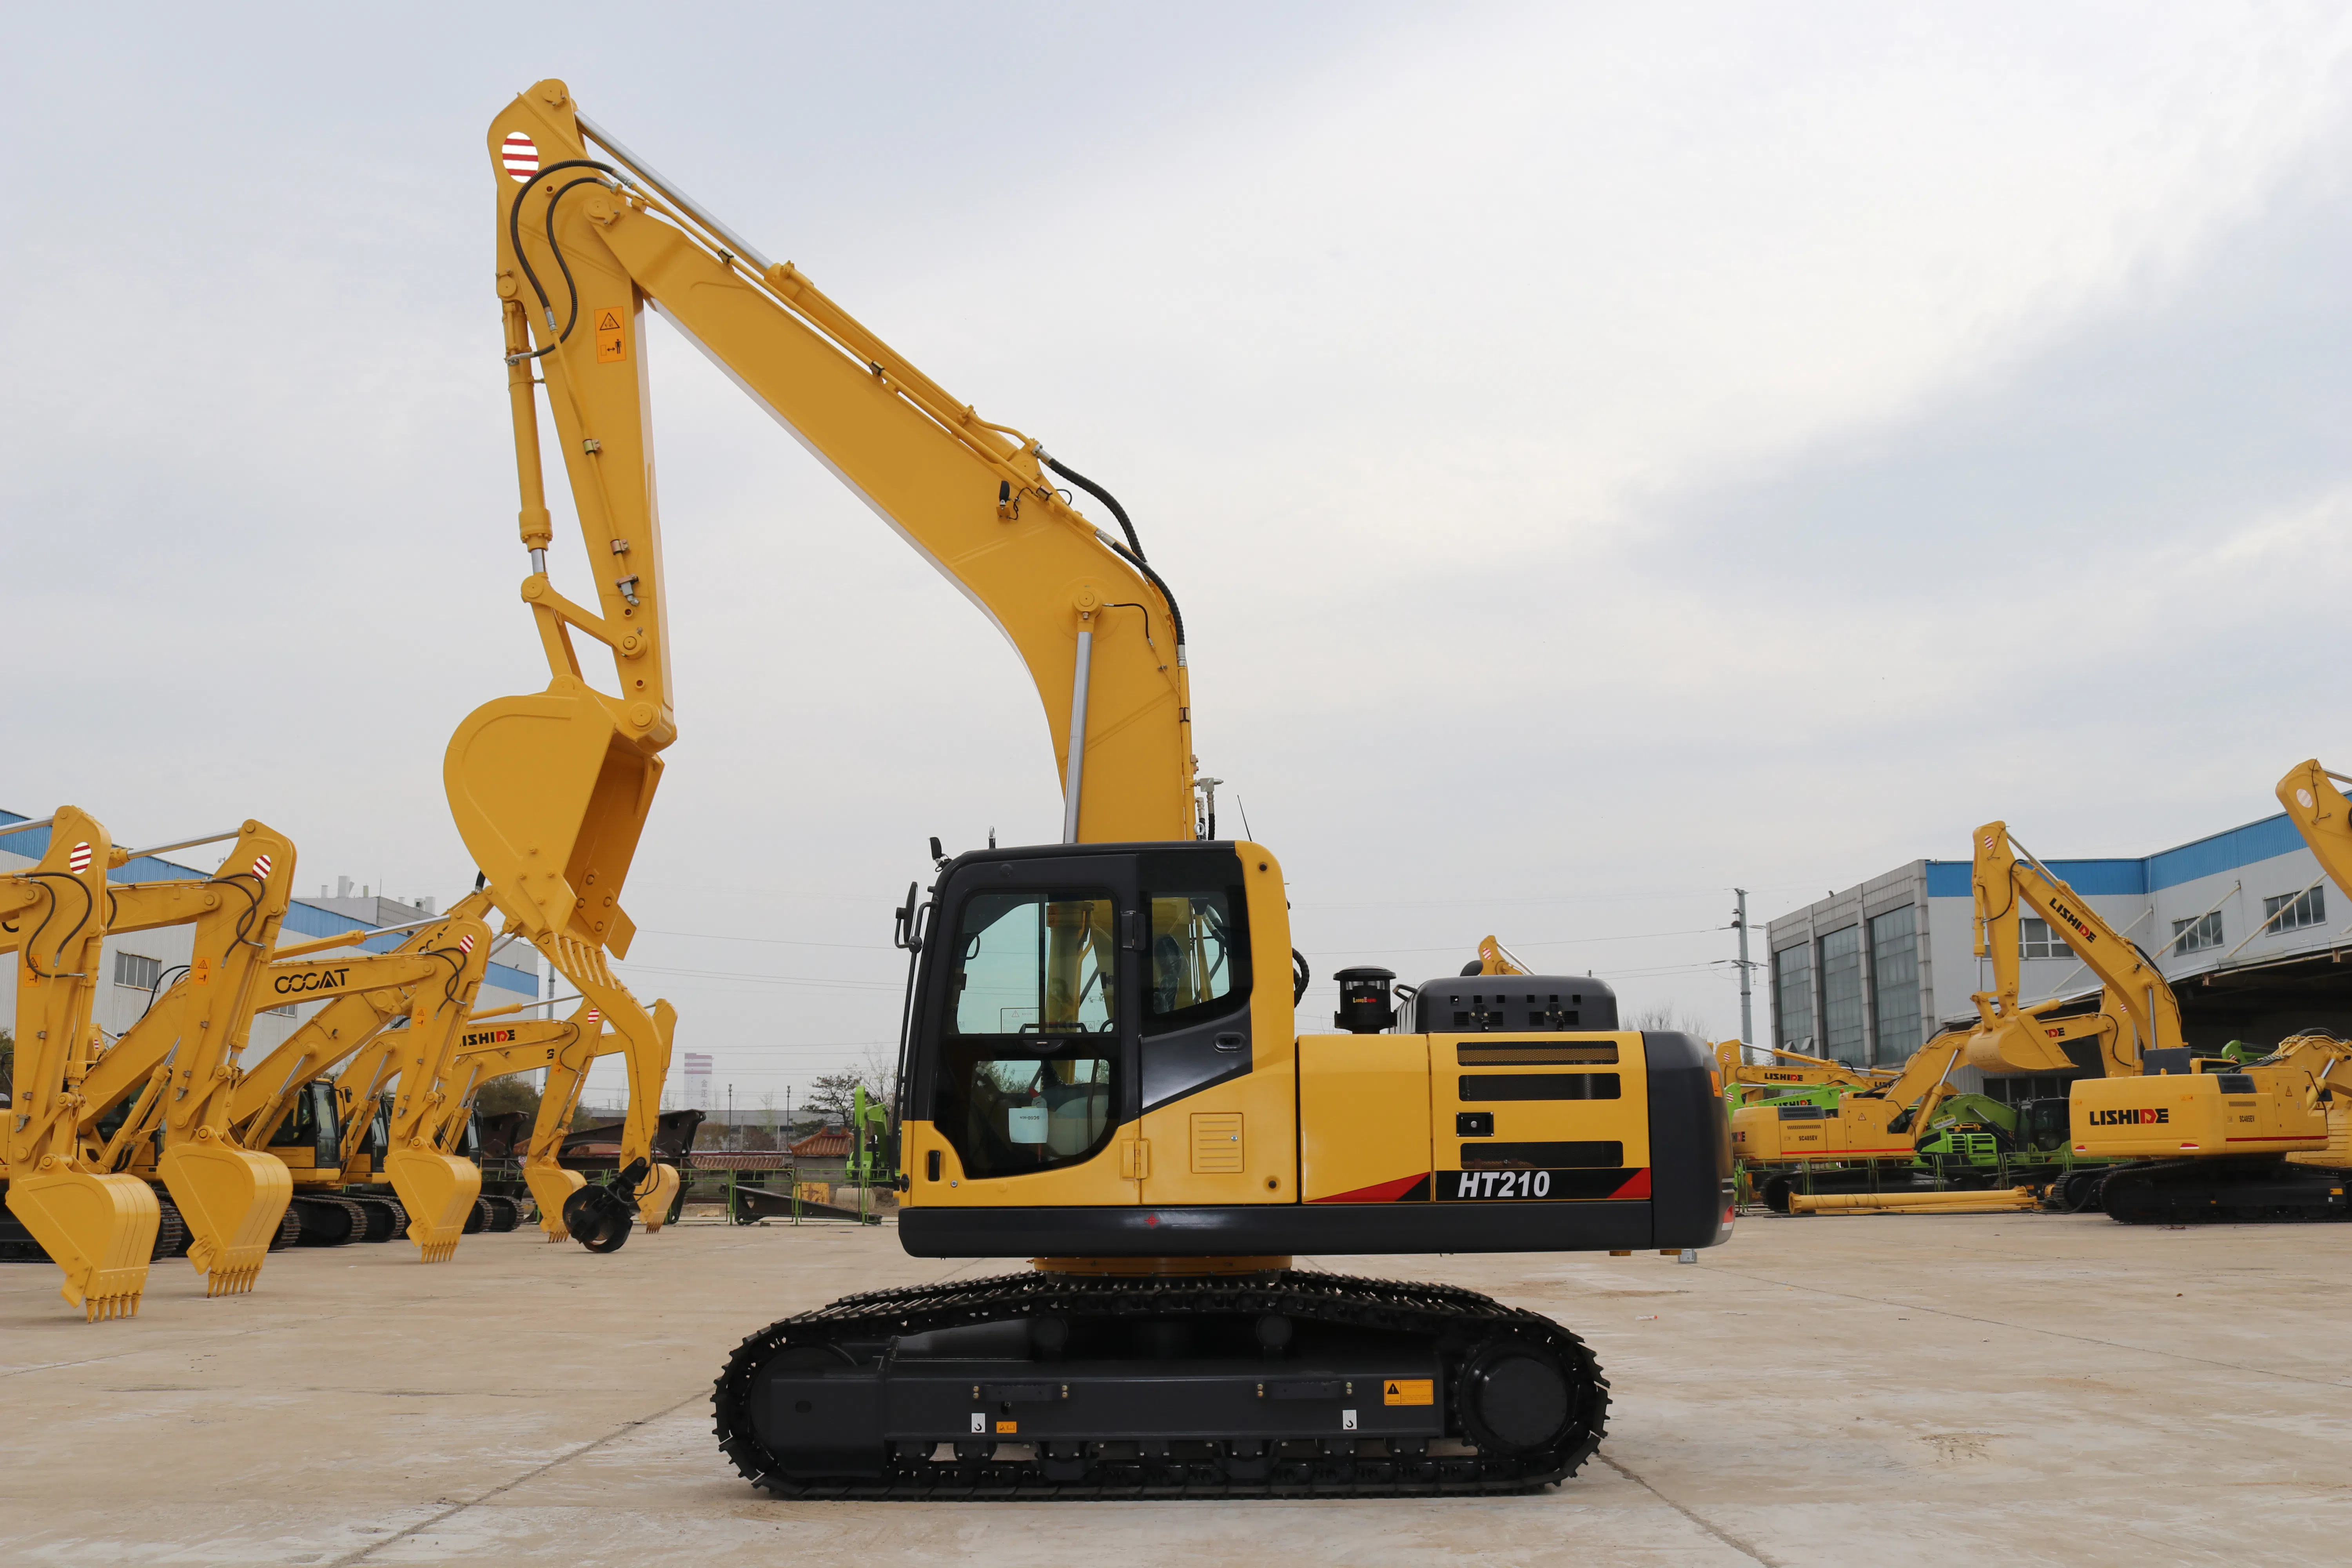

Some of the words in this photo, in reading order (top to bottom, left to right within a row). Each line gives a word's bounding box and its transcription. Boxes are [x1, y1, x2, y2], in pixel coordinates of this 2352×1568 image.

[2049, 897, 2097, 943] LISHIDE
[459, 1029, 515, 1047] ISHIDE
[1764, 1073, 1803, 1081] LISHIDE
[2090, 1108, 2169, 1125] LISHIDE
[1458, 1171, 1550, 1197] HT210
